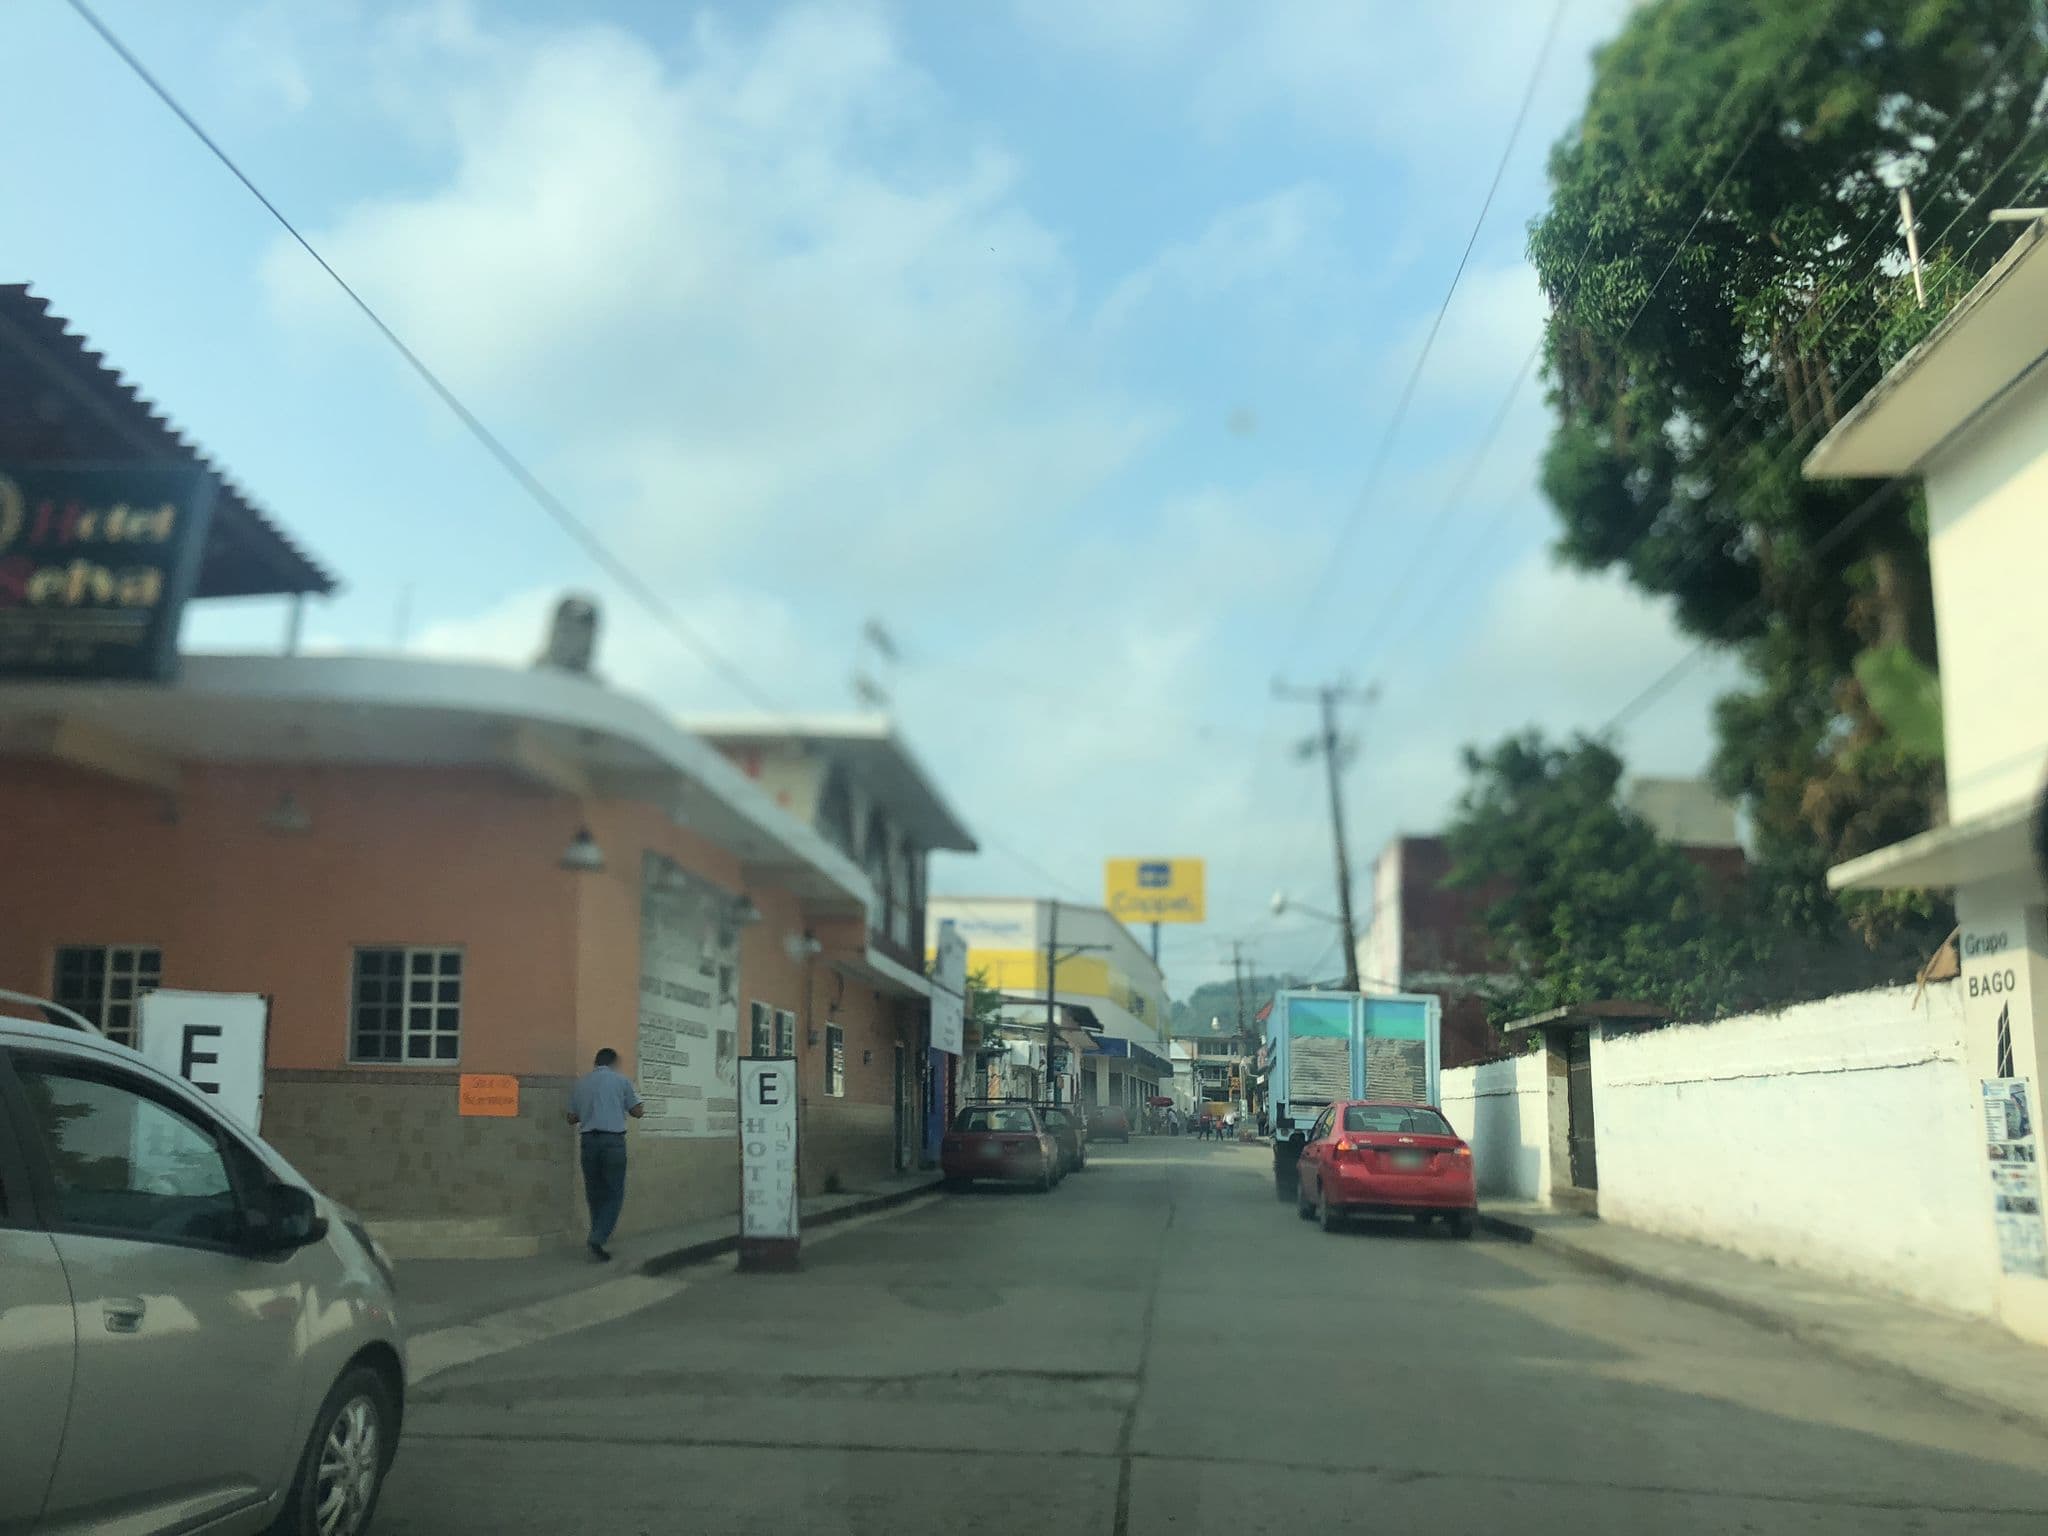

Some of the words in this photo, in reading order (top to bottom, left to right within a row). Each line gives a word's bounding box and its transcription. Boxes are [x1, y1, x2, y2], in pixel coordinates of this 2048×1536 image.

[1965, 930, 2008, 955] Grupo
[1969, 968, 2015, 997] BAGO
[181, 1024, 222, 1094] E
[759, 1073, 778, 1105] E
